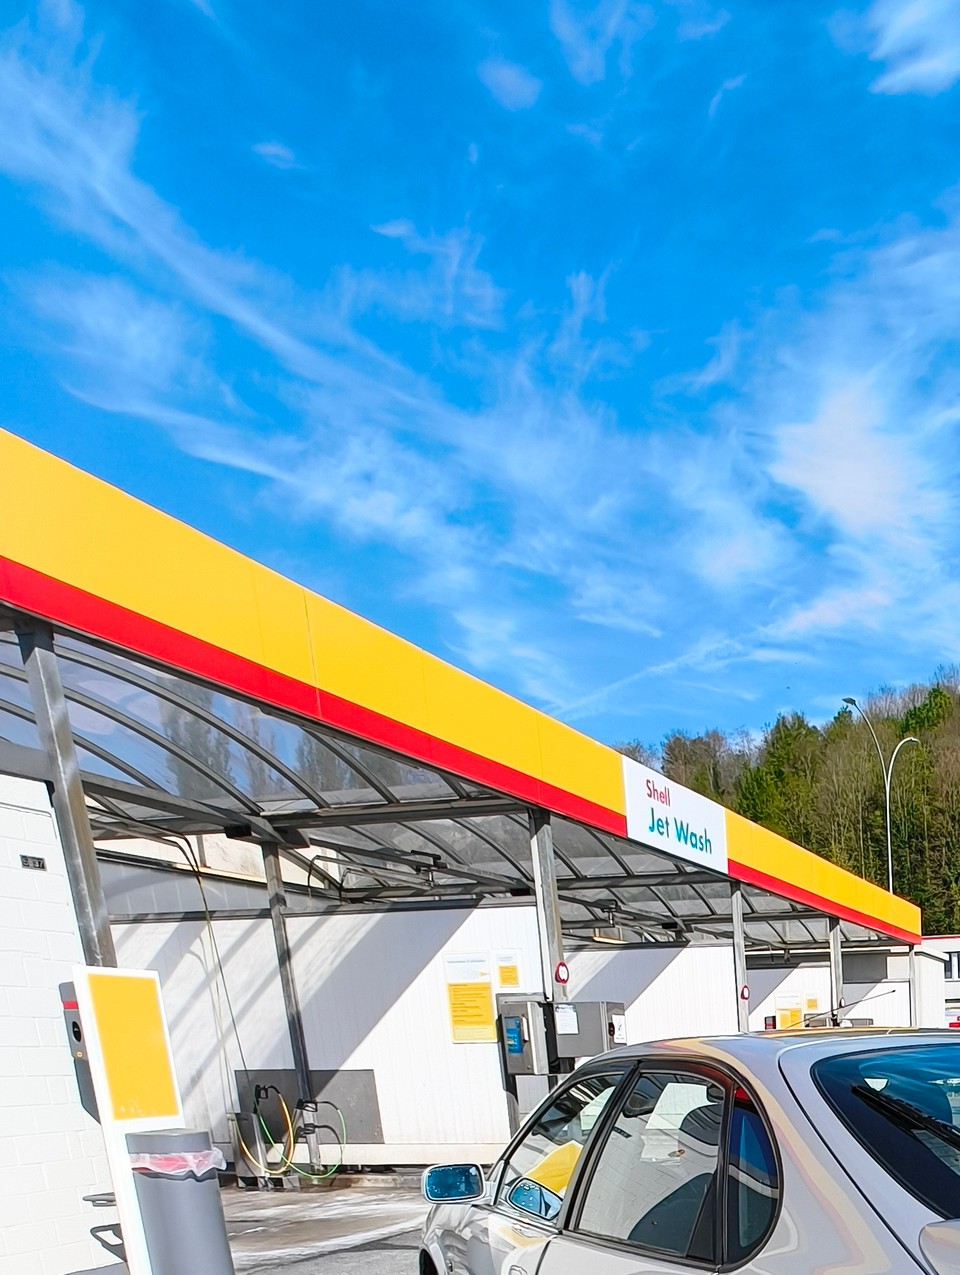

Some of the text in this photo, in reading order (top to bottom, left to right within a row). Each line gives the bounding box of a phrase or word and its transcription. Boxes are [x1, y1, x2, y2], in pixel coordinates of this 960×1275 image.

[645, 779, 671, 807] Shell
[648, 807, 712, 855] Jet Wash
